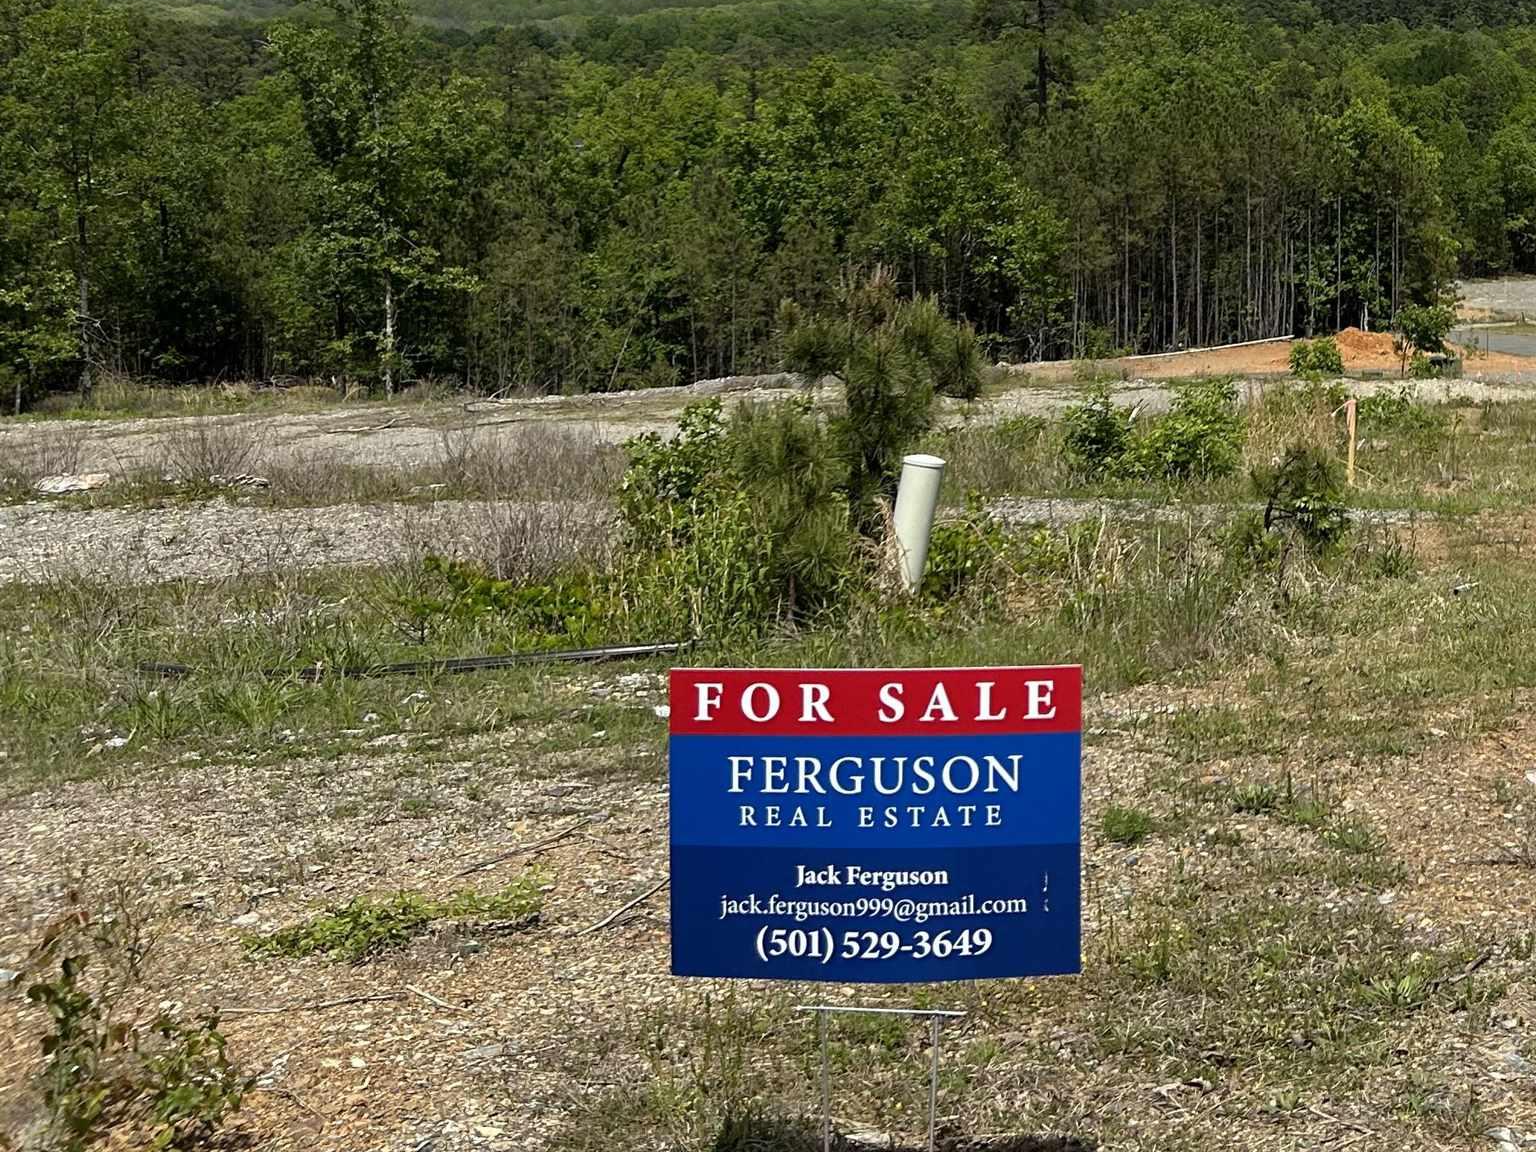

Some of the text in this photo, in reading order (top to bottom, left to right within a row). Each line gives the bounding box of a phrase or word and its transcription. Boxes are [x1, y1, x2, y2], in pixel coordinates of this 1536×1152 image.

[693, 680, 1057, 722] FOR SALE
[727, 754, 1023, 795] FERGUSON
[739, 805, 1002, 828] REAL ESTATE
[796, 864, 949, 892] Jack Ferguson
[719, 893, 1027, 923] jack.ferguson999@gmail.com
[756, 925, 993, 964] (501) 529-3649
